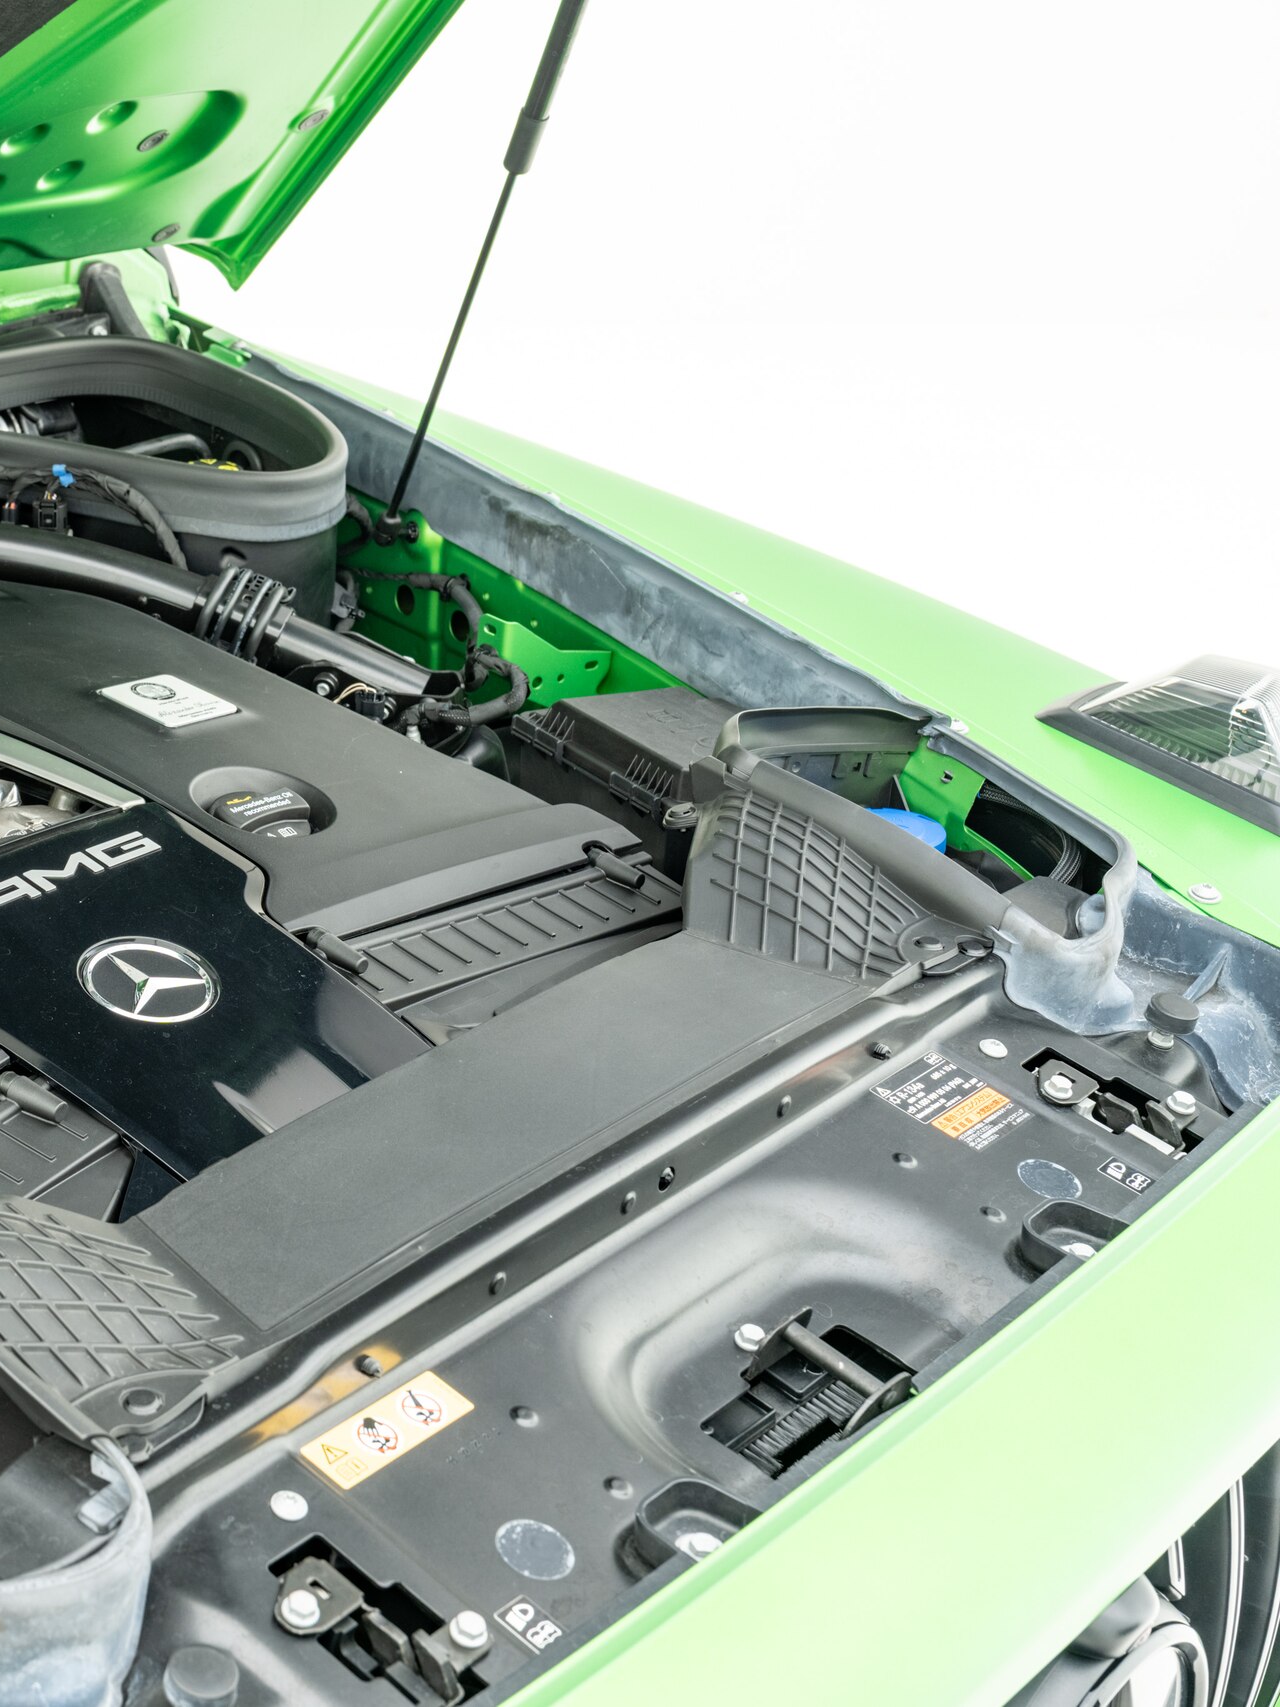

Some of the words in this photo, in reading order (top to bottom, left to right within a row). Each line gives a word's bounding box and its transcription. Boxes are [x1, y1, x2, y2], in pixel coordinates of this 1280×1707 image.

[229, 794, 282, 814] Mercedes-Benz
[281, 791, 294, 799] Oil
[243, 798, 292, 817] recommended
[899, 1082, 926, 1101] R-134a
